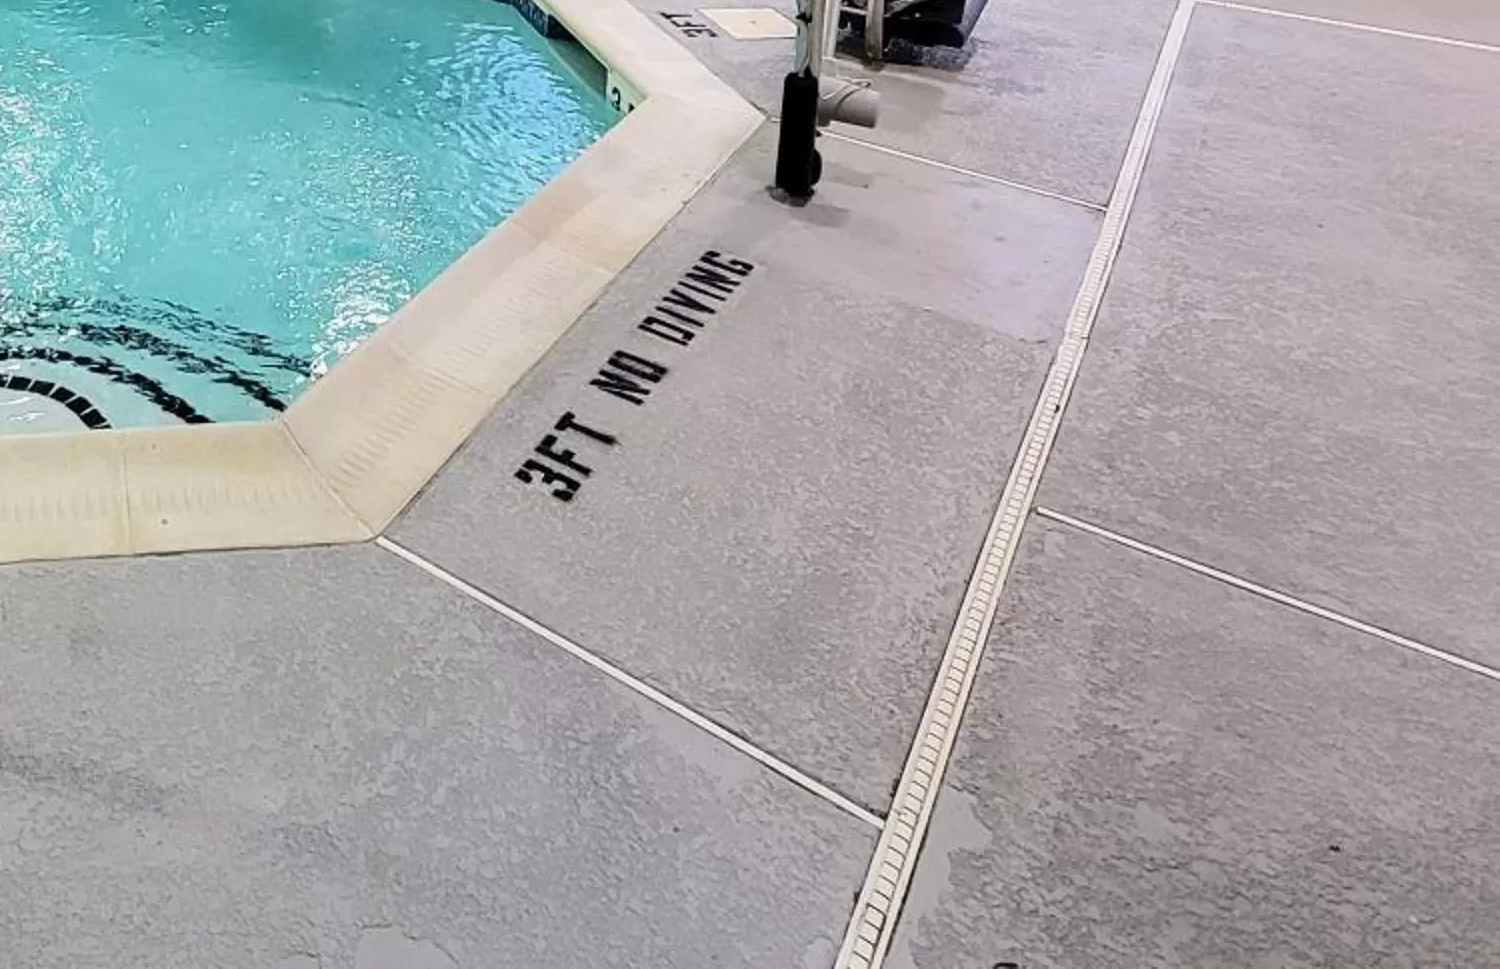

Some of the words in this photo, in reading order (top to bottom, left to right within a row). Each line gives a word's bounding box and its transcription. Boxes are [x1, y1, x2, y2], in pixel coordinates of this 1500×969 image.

[513, 411, 619, 502] 3FT
[588, 349, 670, 407] NO
[637, 249, 755, 347] DIVING
